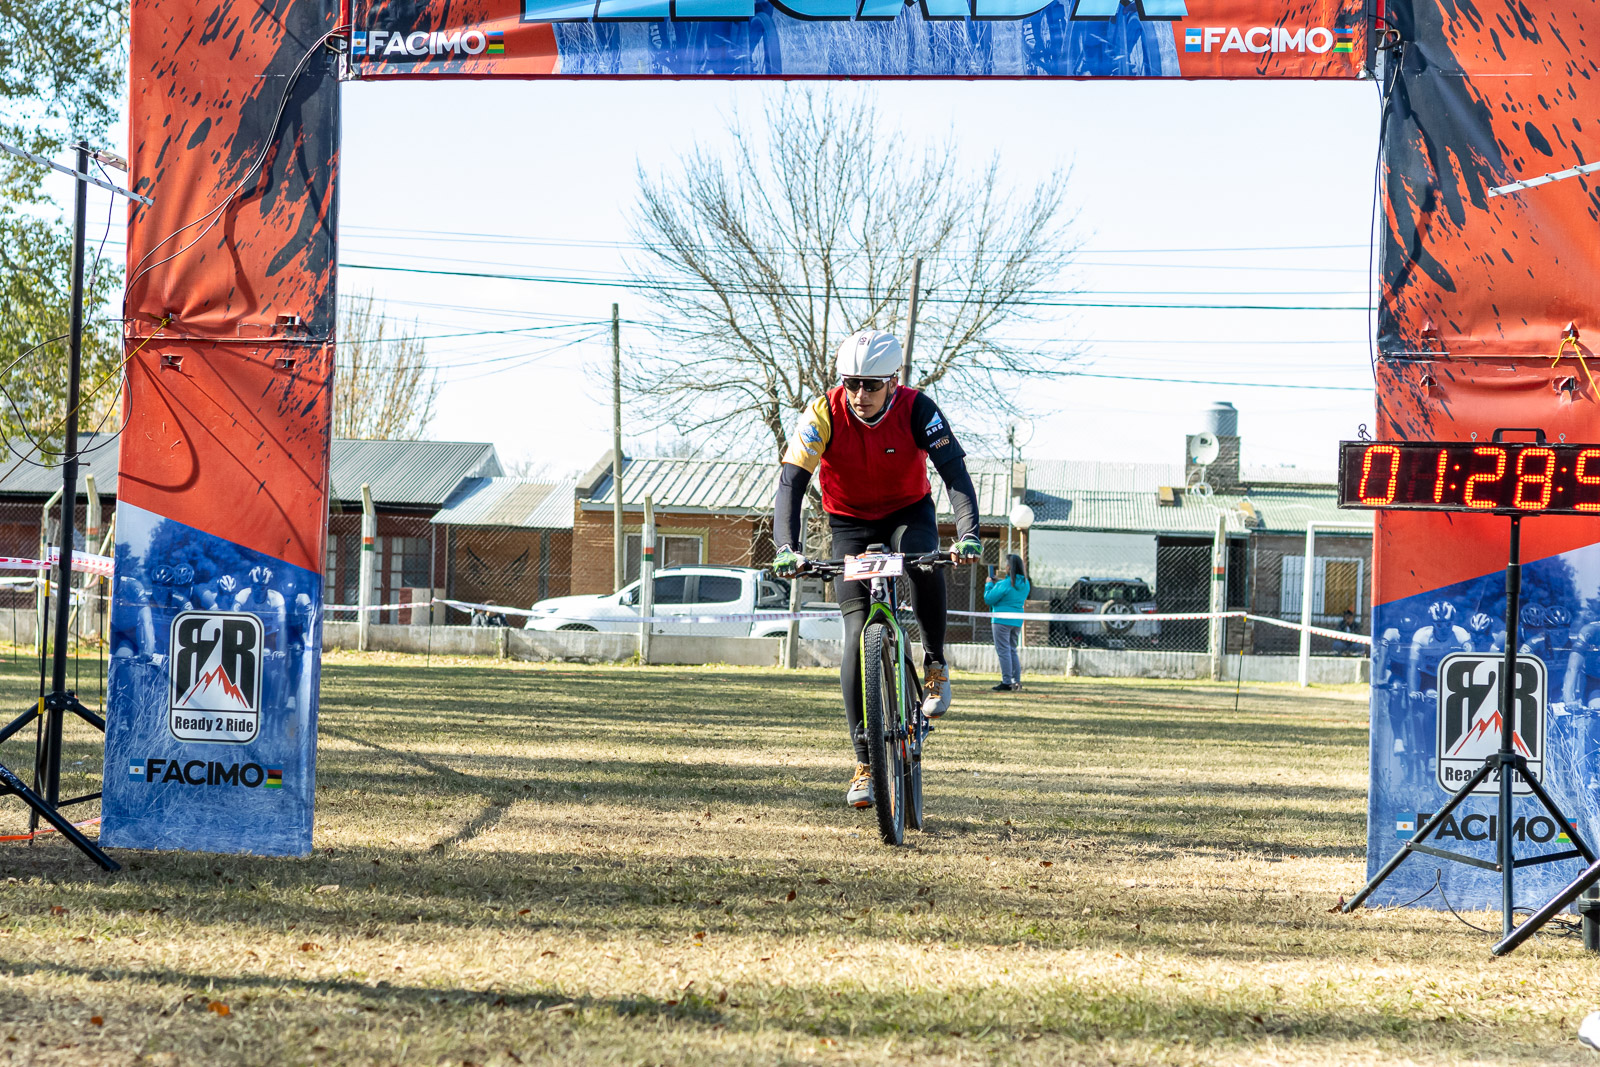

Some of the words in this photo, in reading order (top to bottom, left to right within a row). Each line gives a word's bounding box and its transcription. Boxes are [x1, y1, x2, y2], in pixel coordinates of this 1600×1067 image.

[367, 30, 487, 55] FACIMO
[1203, 26, 1334, 54] FACIMO
[857, 559, 888, 574] 31
[175, 715, 213, 732] Ready
[215, 717, 224, 731] 2
[226, 718, 254, 733] Ride
[146, 758, 264, 788] FACIMO
